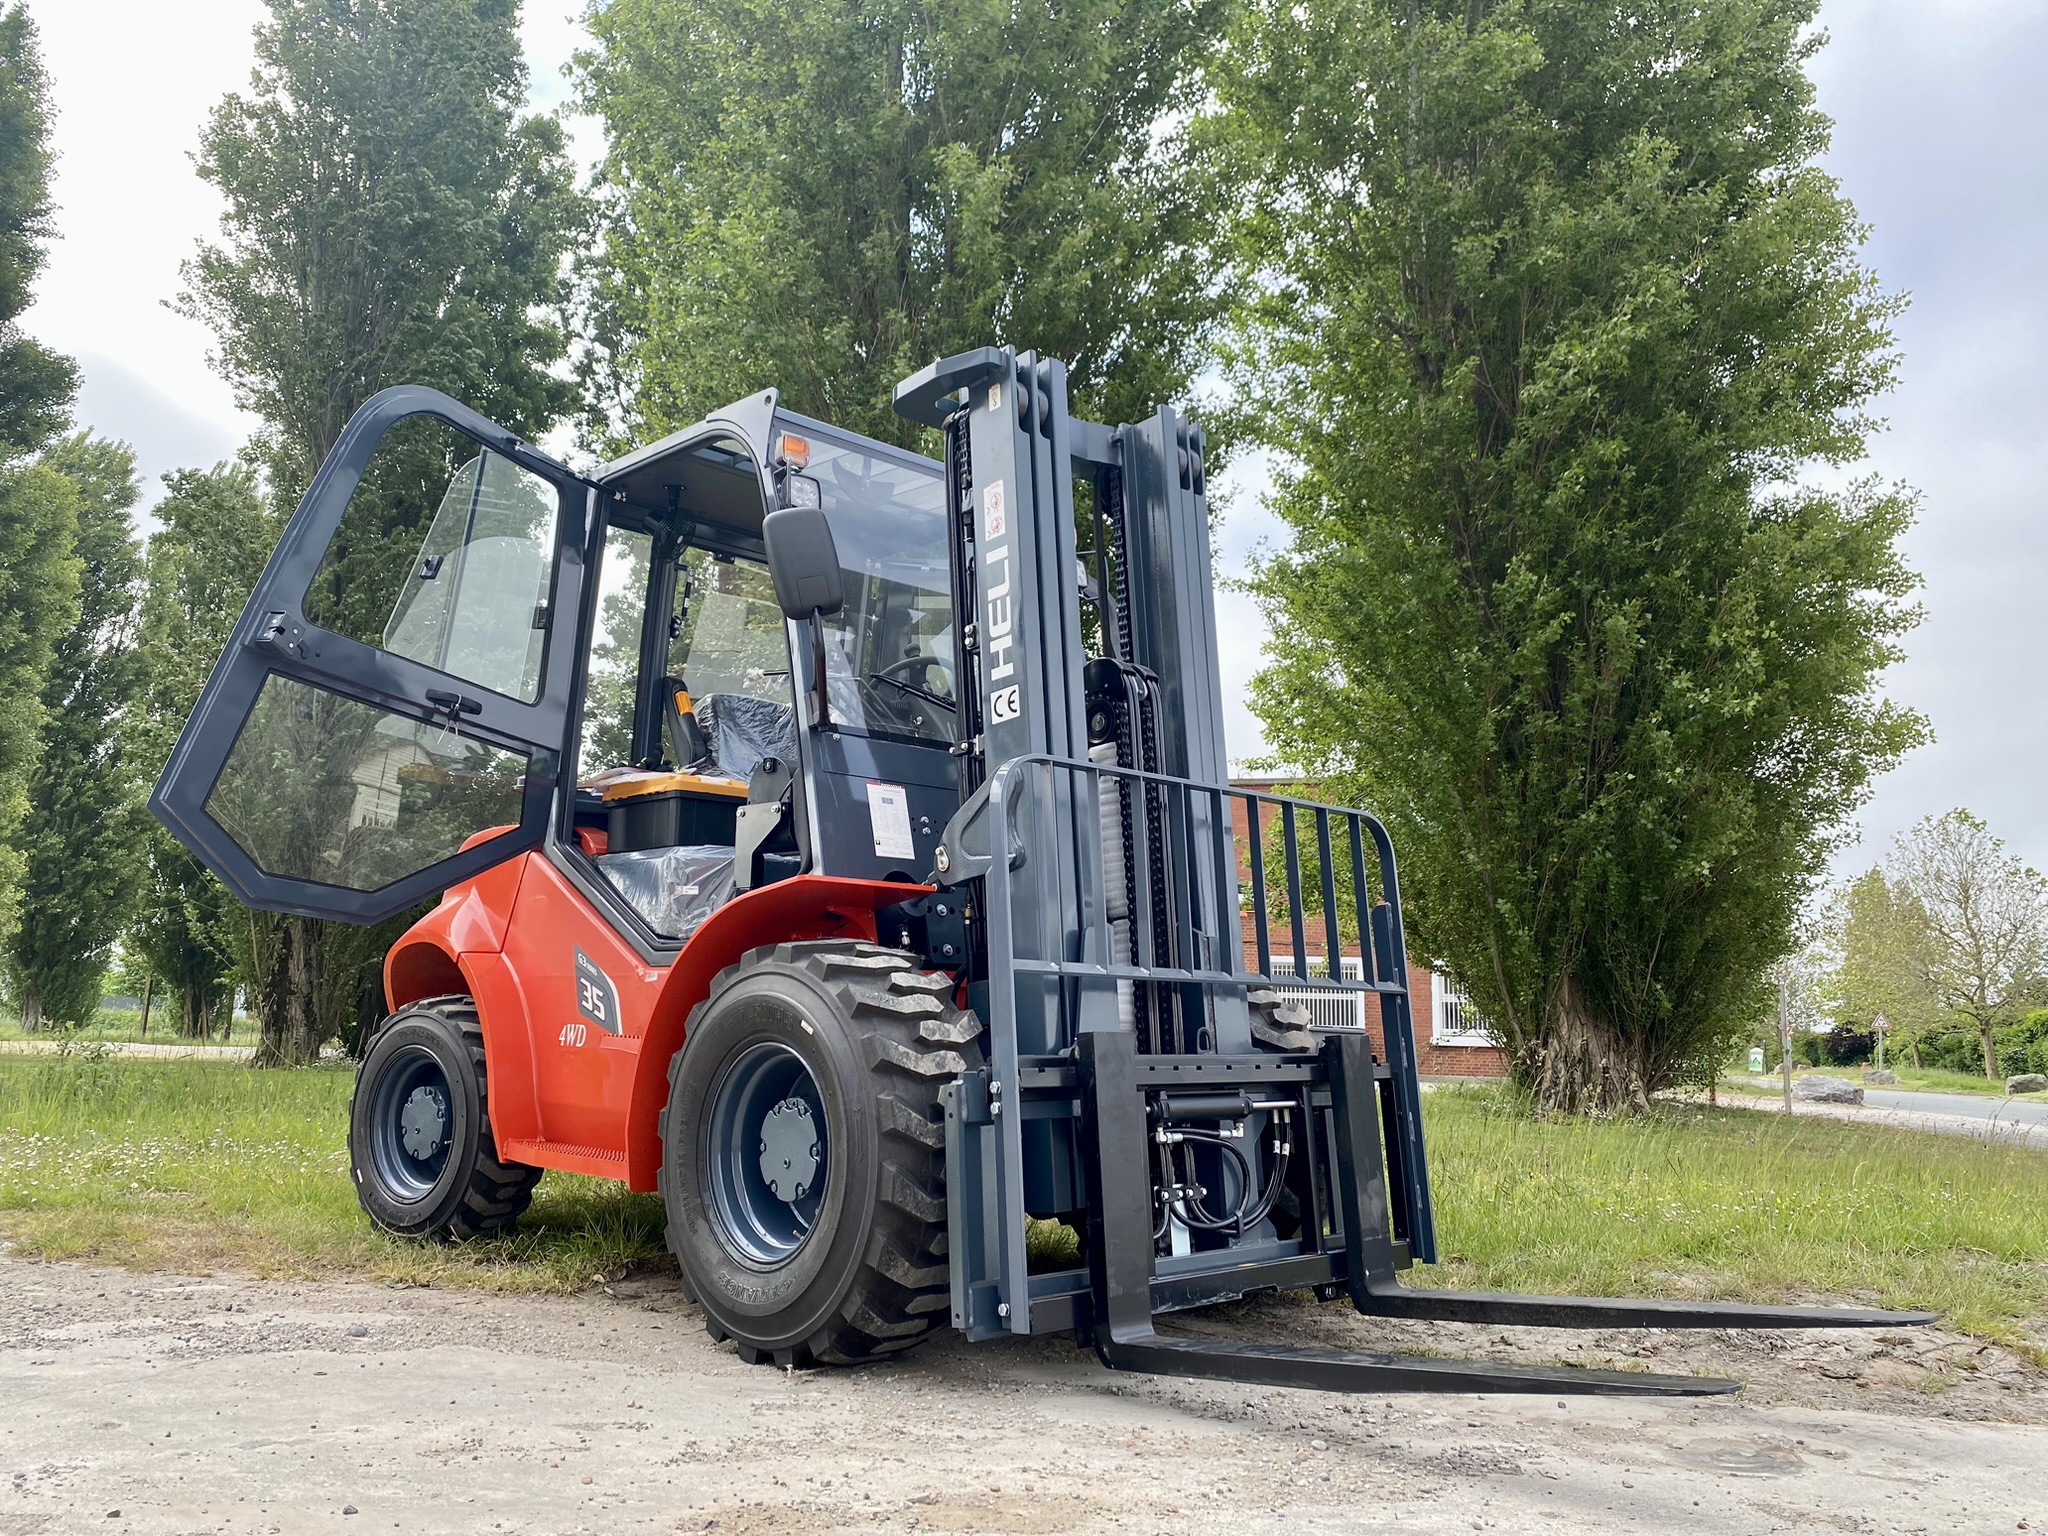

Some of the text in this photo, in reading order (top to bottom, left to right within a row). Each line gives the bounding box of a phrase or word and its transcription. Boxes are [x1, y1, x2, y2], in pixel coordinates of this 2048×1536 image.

[986, 544, 1014, 681] HELI
[993, 689, 1019, 718] CE
[580, 977, 606, 1022] 35
[558, 1023, 587, 1048] 4WD
